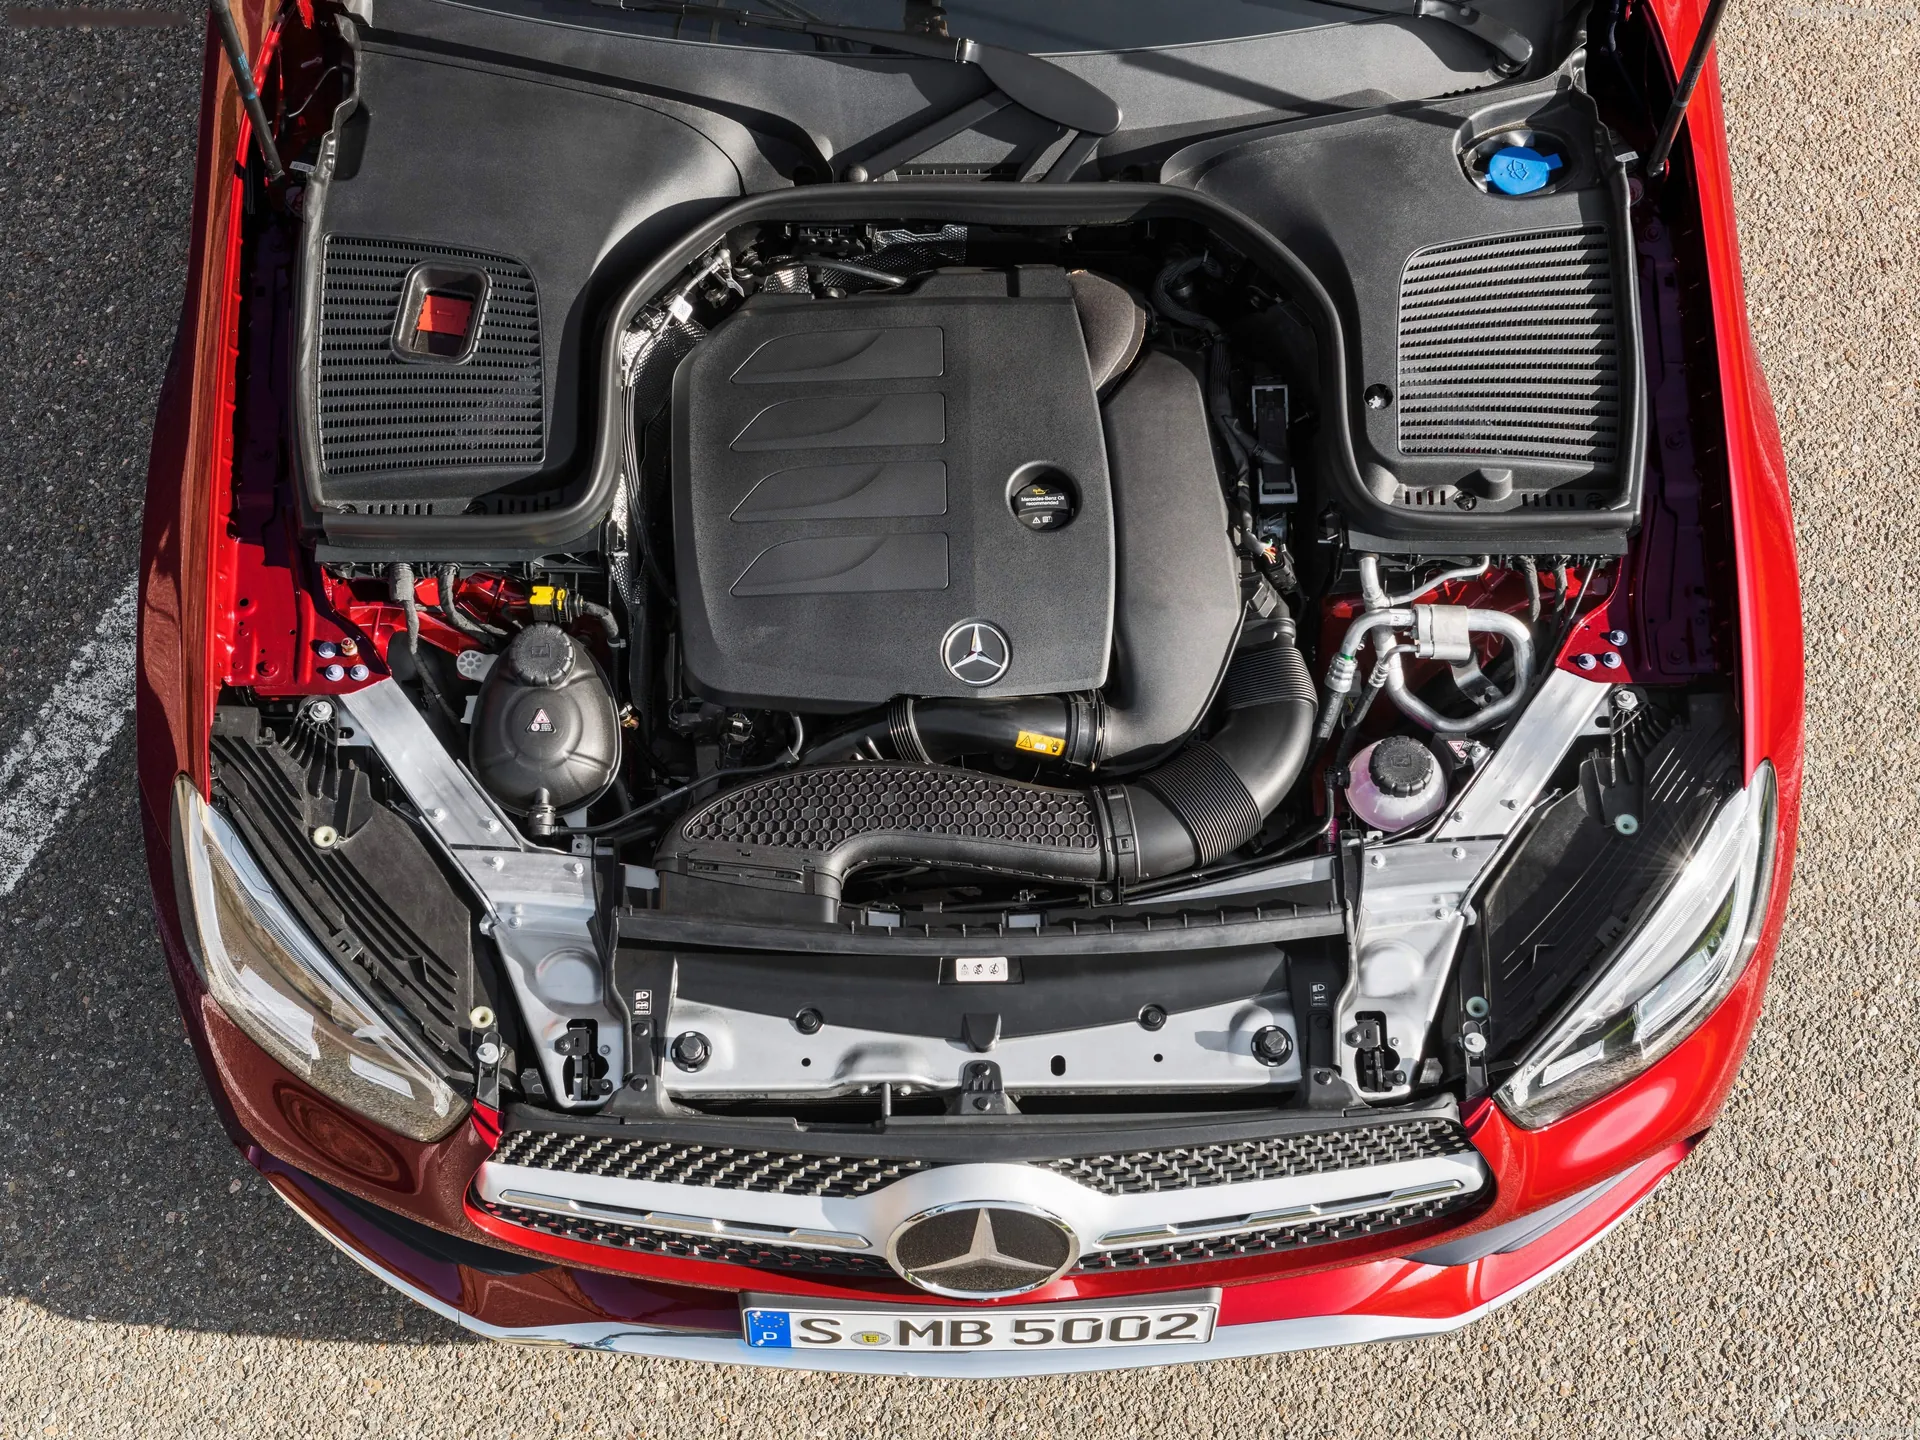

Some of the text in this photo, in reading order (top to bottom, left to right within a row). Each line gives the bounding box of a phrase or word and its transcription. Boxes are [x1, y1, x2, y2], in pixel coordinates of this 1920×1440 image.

[763, 1331, 778, 1340] D
[799, 1312, 1200, 1347] S MB 5002
